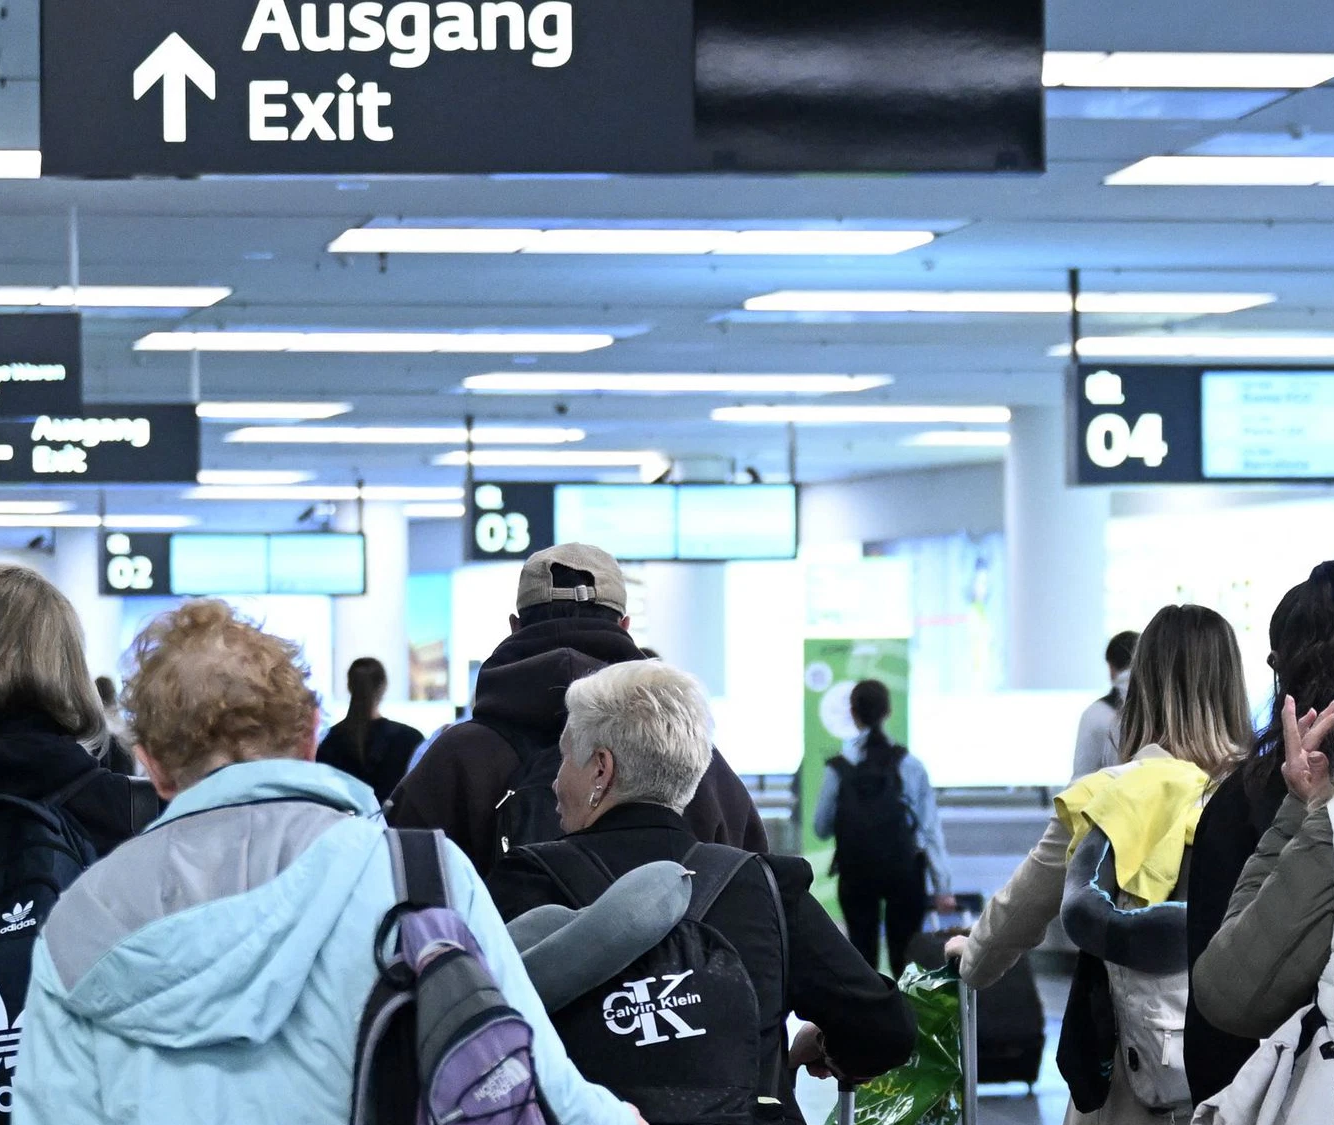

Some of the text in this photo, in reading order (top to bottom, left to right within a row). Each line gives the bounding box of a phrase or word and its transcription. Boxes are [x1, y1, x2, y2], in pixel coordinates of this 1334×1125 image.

[242, 0, 573, 69] Ausgang
[248, 73, 394, 142] Exit
[1085, 412, 1169, 468] 04
[475, 512, 531, 553] 03
[107, 555, 154, 590] 02
[0, 918, 37, 935] adidas
[603, 993, 702, 1021] Calvin Klein
